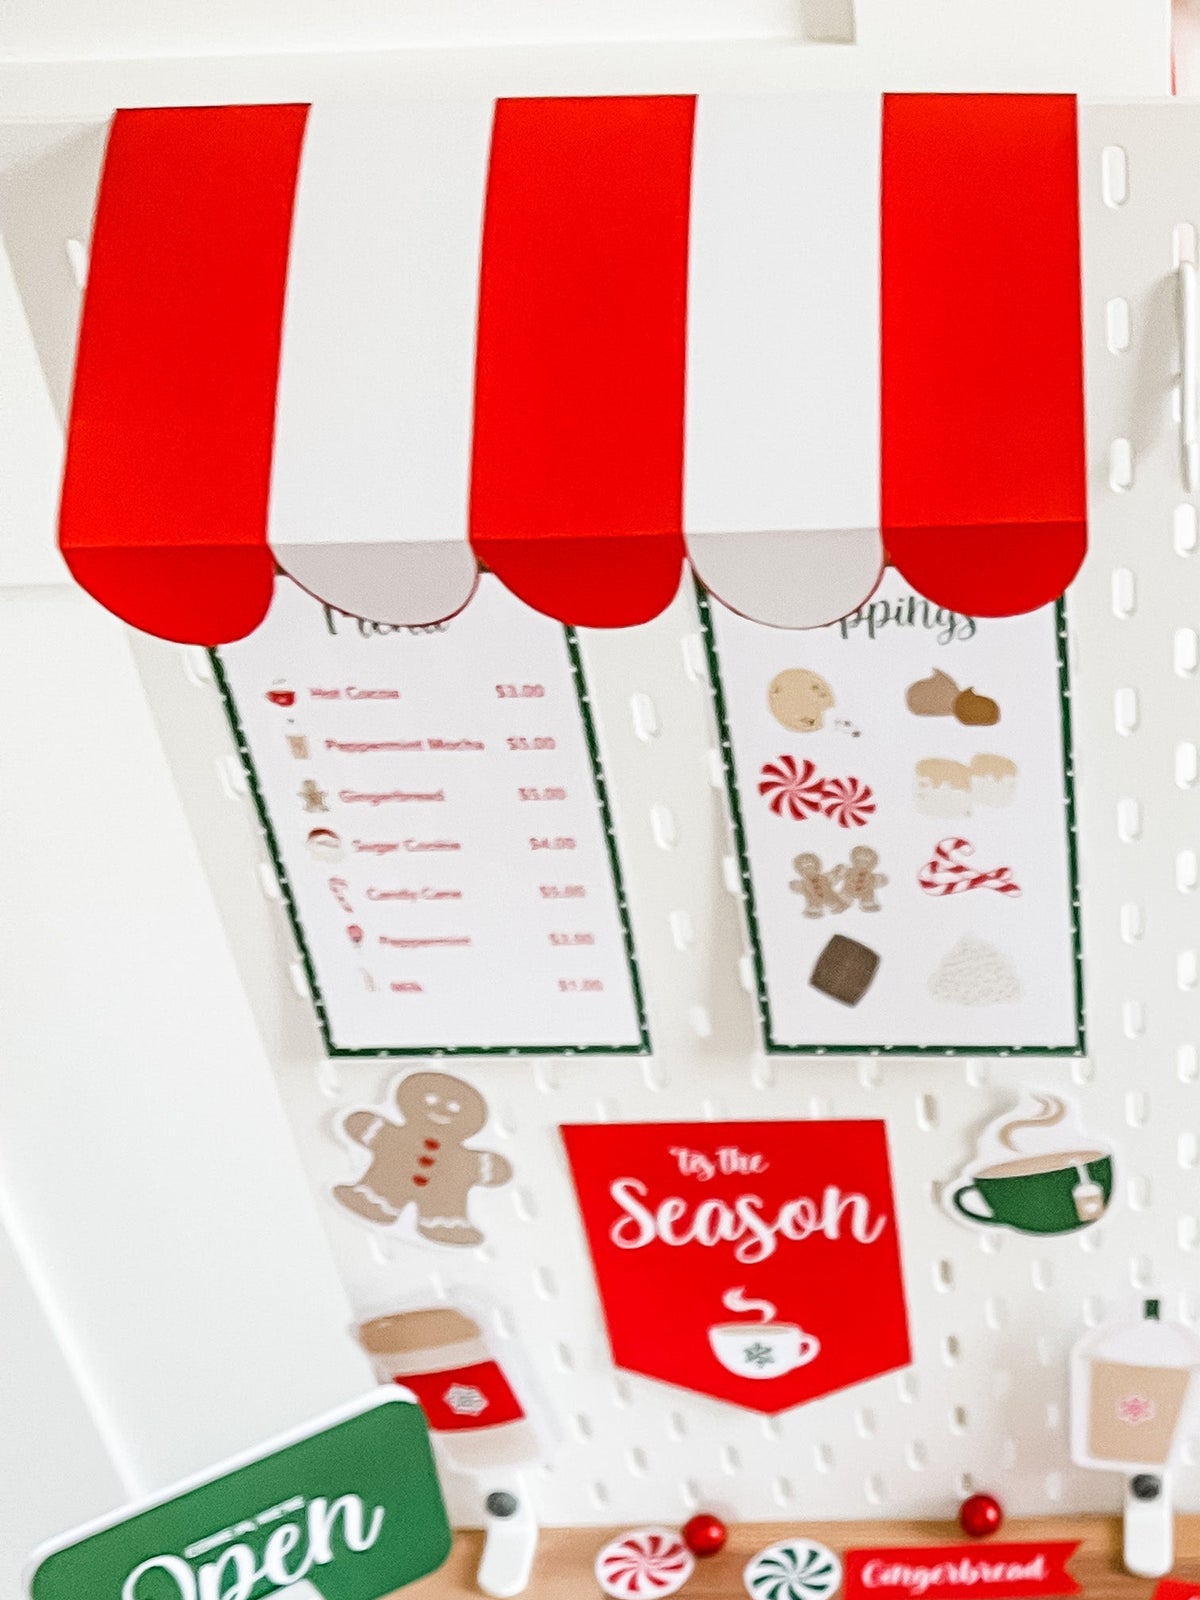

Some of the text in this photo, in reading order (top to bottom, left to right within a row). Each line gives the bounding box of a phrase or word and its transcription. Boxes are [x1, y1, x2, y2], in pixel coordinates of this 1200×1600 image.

[839, 596, 978, 646] ppings
[715, 1146, 770, 1176] the
[609, 1176, 887, 1264] Season
[861, 1551, 1050, 1596] Gingerbread
